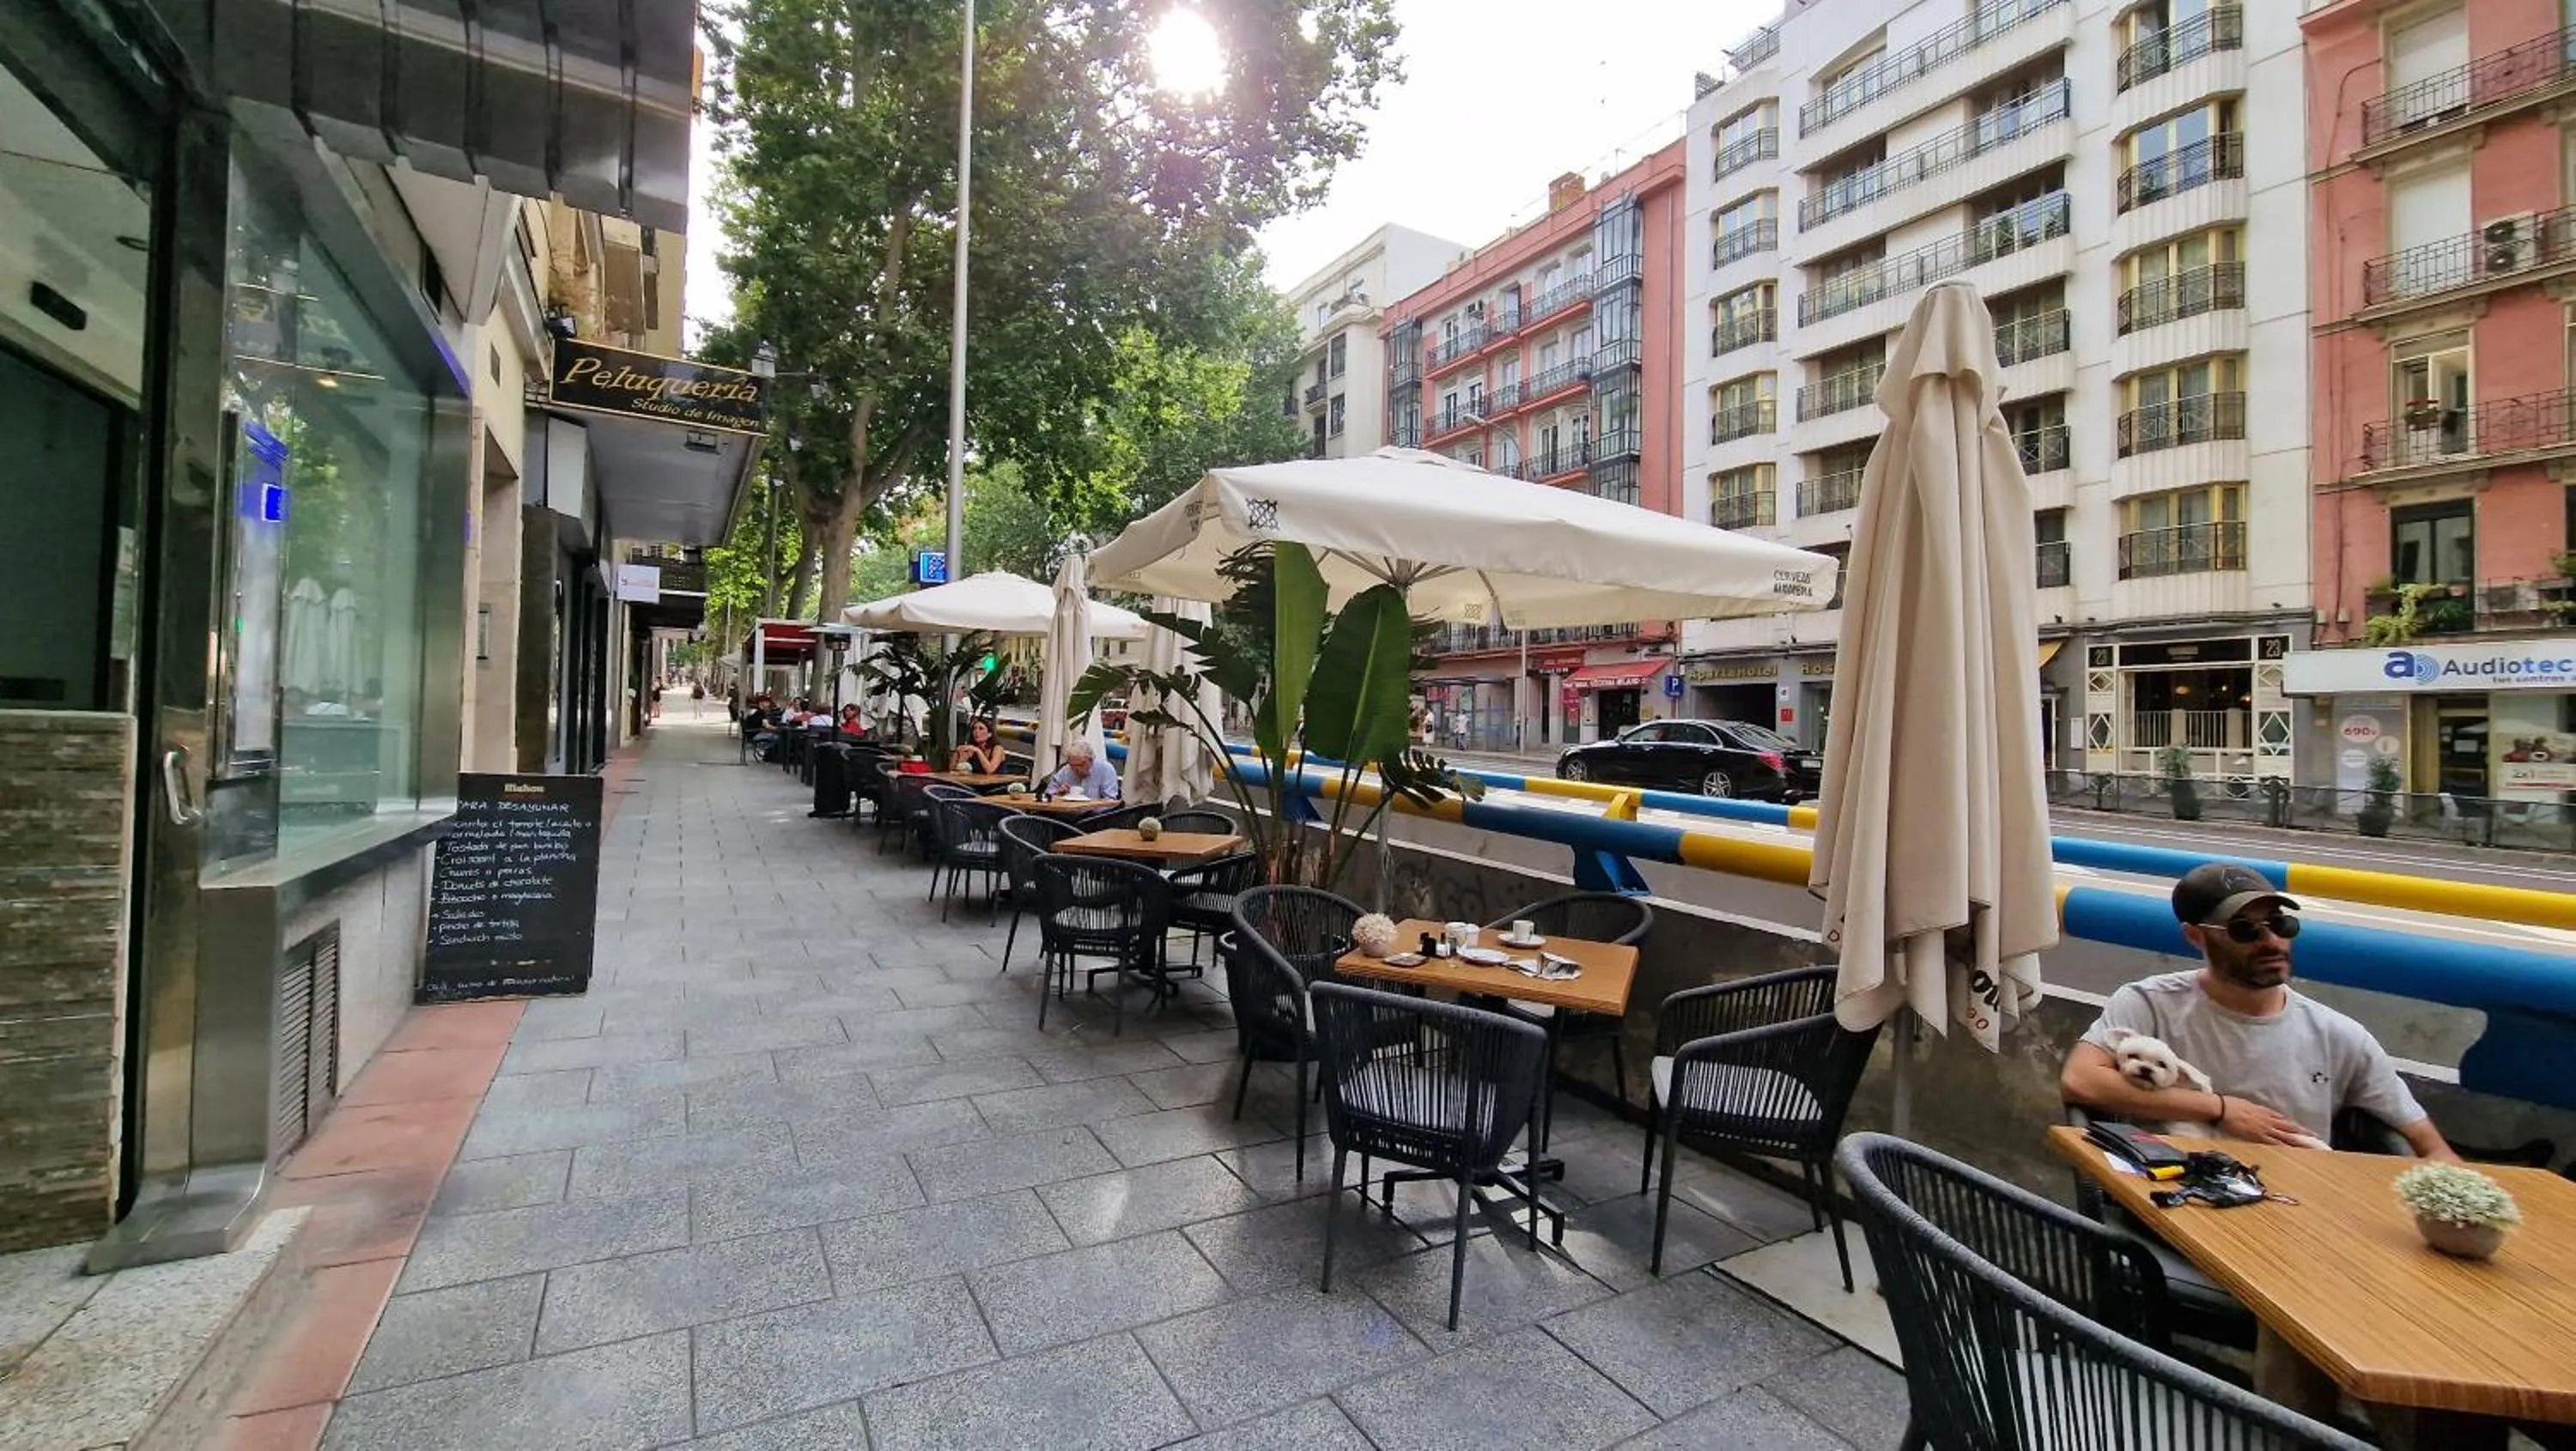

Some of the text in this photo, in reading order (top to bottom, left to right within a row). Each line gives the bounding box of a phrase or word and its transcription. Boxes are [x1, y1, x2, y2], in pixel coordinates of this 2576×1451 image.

[560, 357, 758, 404] Peluquería
[631, 397, 760, 428] Studio de Imagen
[2266, 639, 2281, 658] 23
[2442, 655, 2573, 676] Audiotec
[1673, 677, 1679, 686] P
[498, 801, 570, 813] DESAYUNAR
[519, 852, 532, 863] la
[533, 851, 576, 865] plancha
